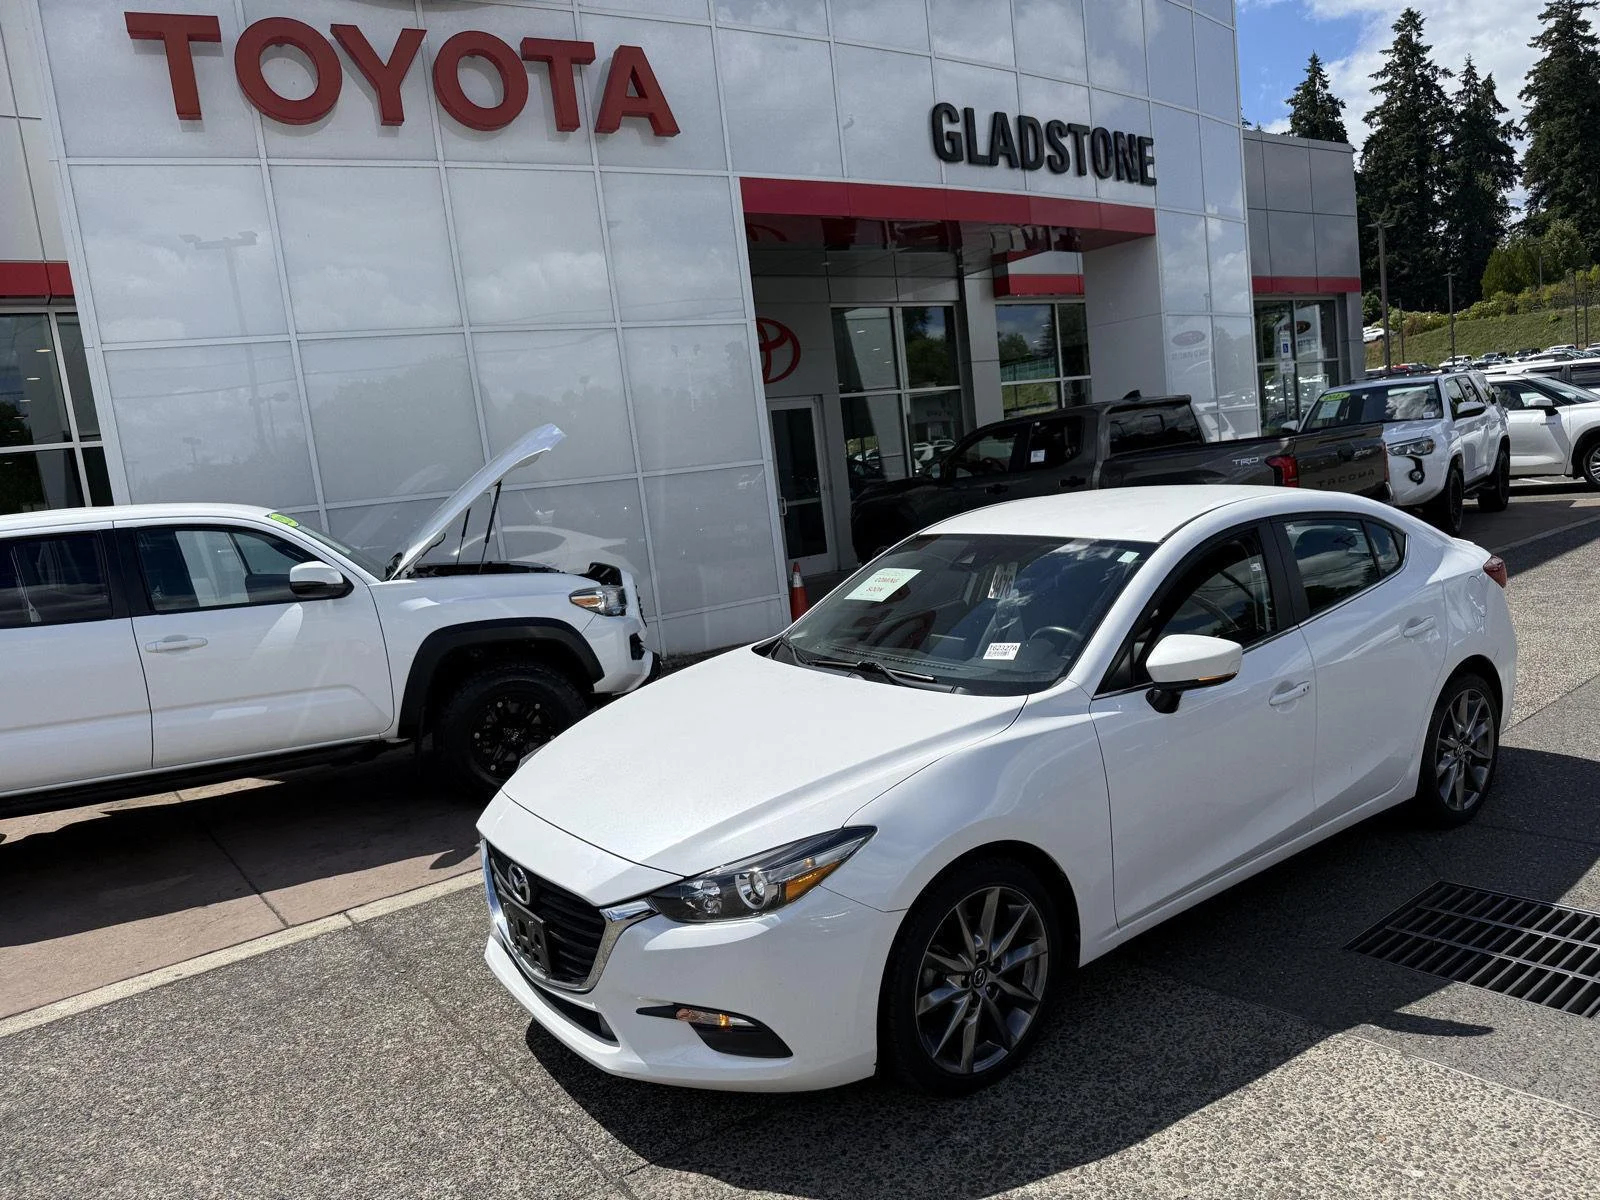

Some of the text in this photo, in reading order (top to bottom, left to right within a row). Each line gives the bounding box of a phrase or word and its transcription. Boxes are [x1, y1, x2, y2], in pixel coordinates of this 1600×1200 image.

[124, 12, 680, 137] TOYOTA
[931, 102, 1157, 186] GLADSTONE
[1232, 457, 1258, 466] TRD
[1316, 469, 1375, 487] TACOMA
